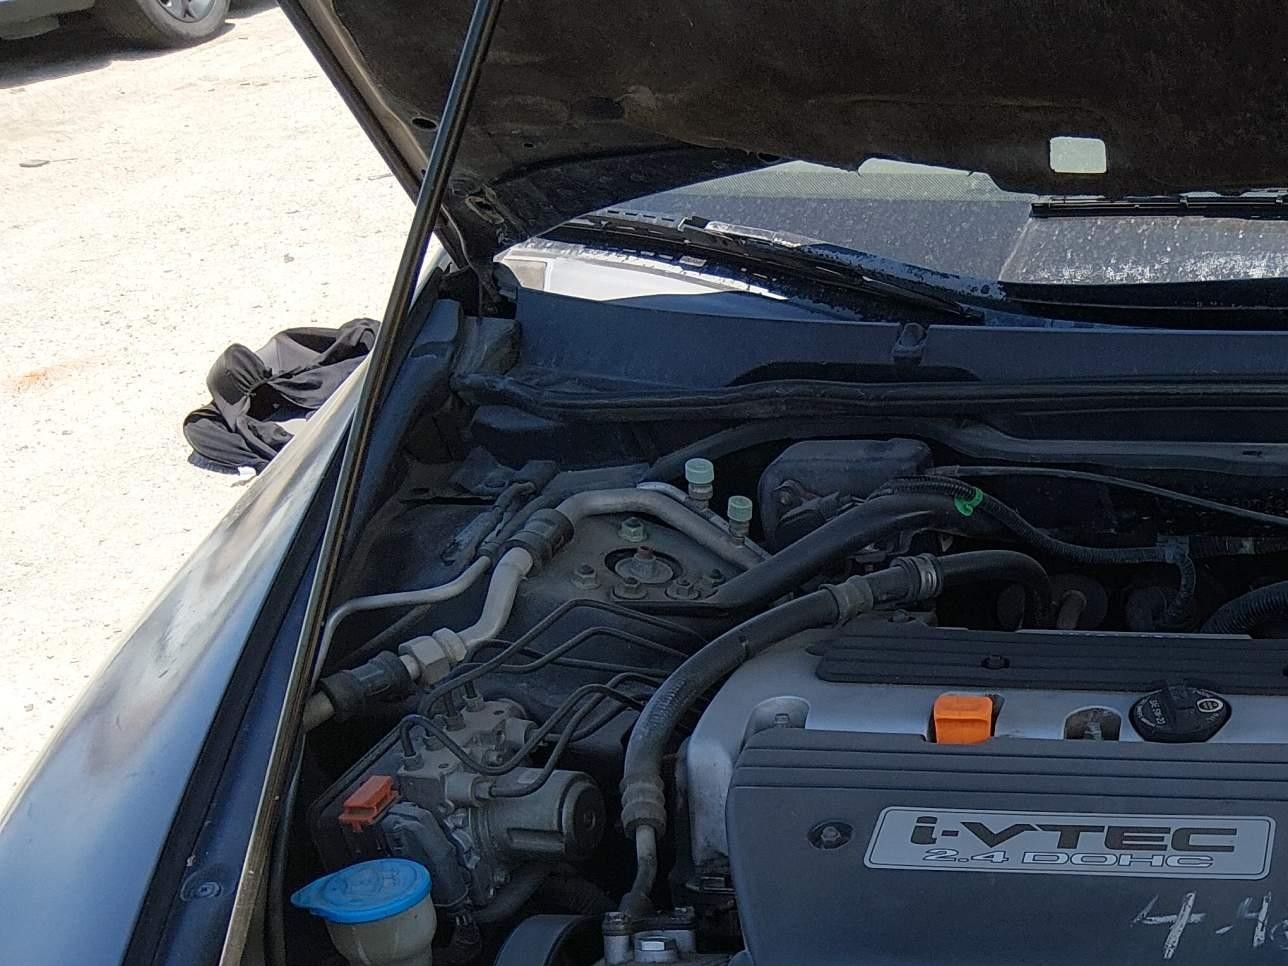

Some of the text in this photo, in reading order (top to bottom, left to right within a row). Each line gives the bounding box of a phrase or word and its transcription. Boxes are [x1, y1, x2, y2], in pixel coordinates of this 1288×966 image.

[910, 815, 1238, 852] i-VTEC
[922, 848, 1214, 868] 2.4 DOHC
